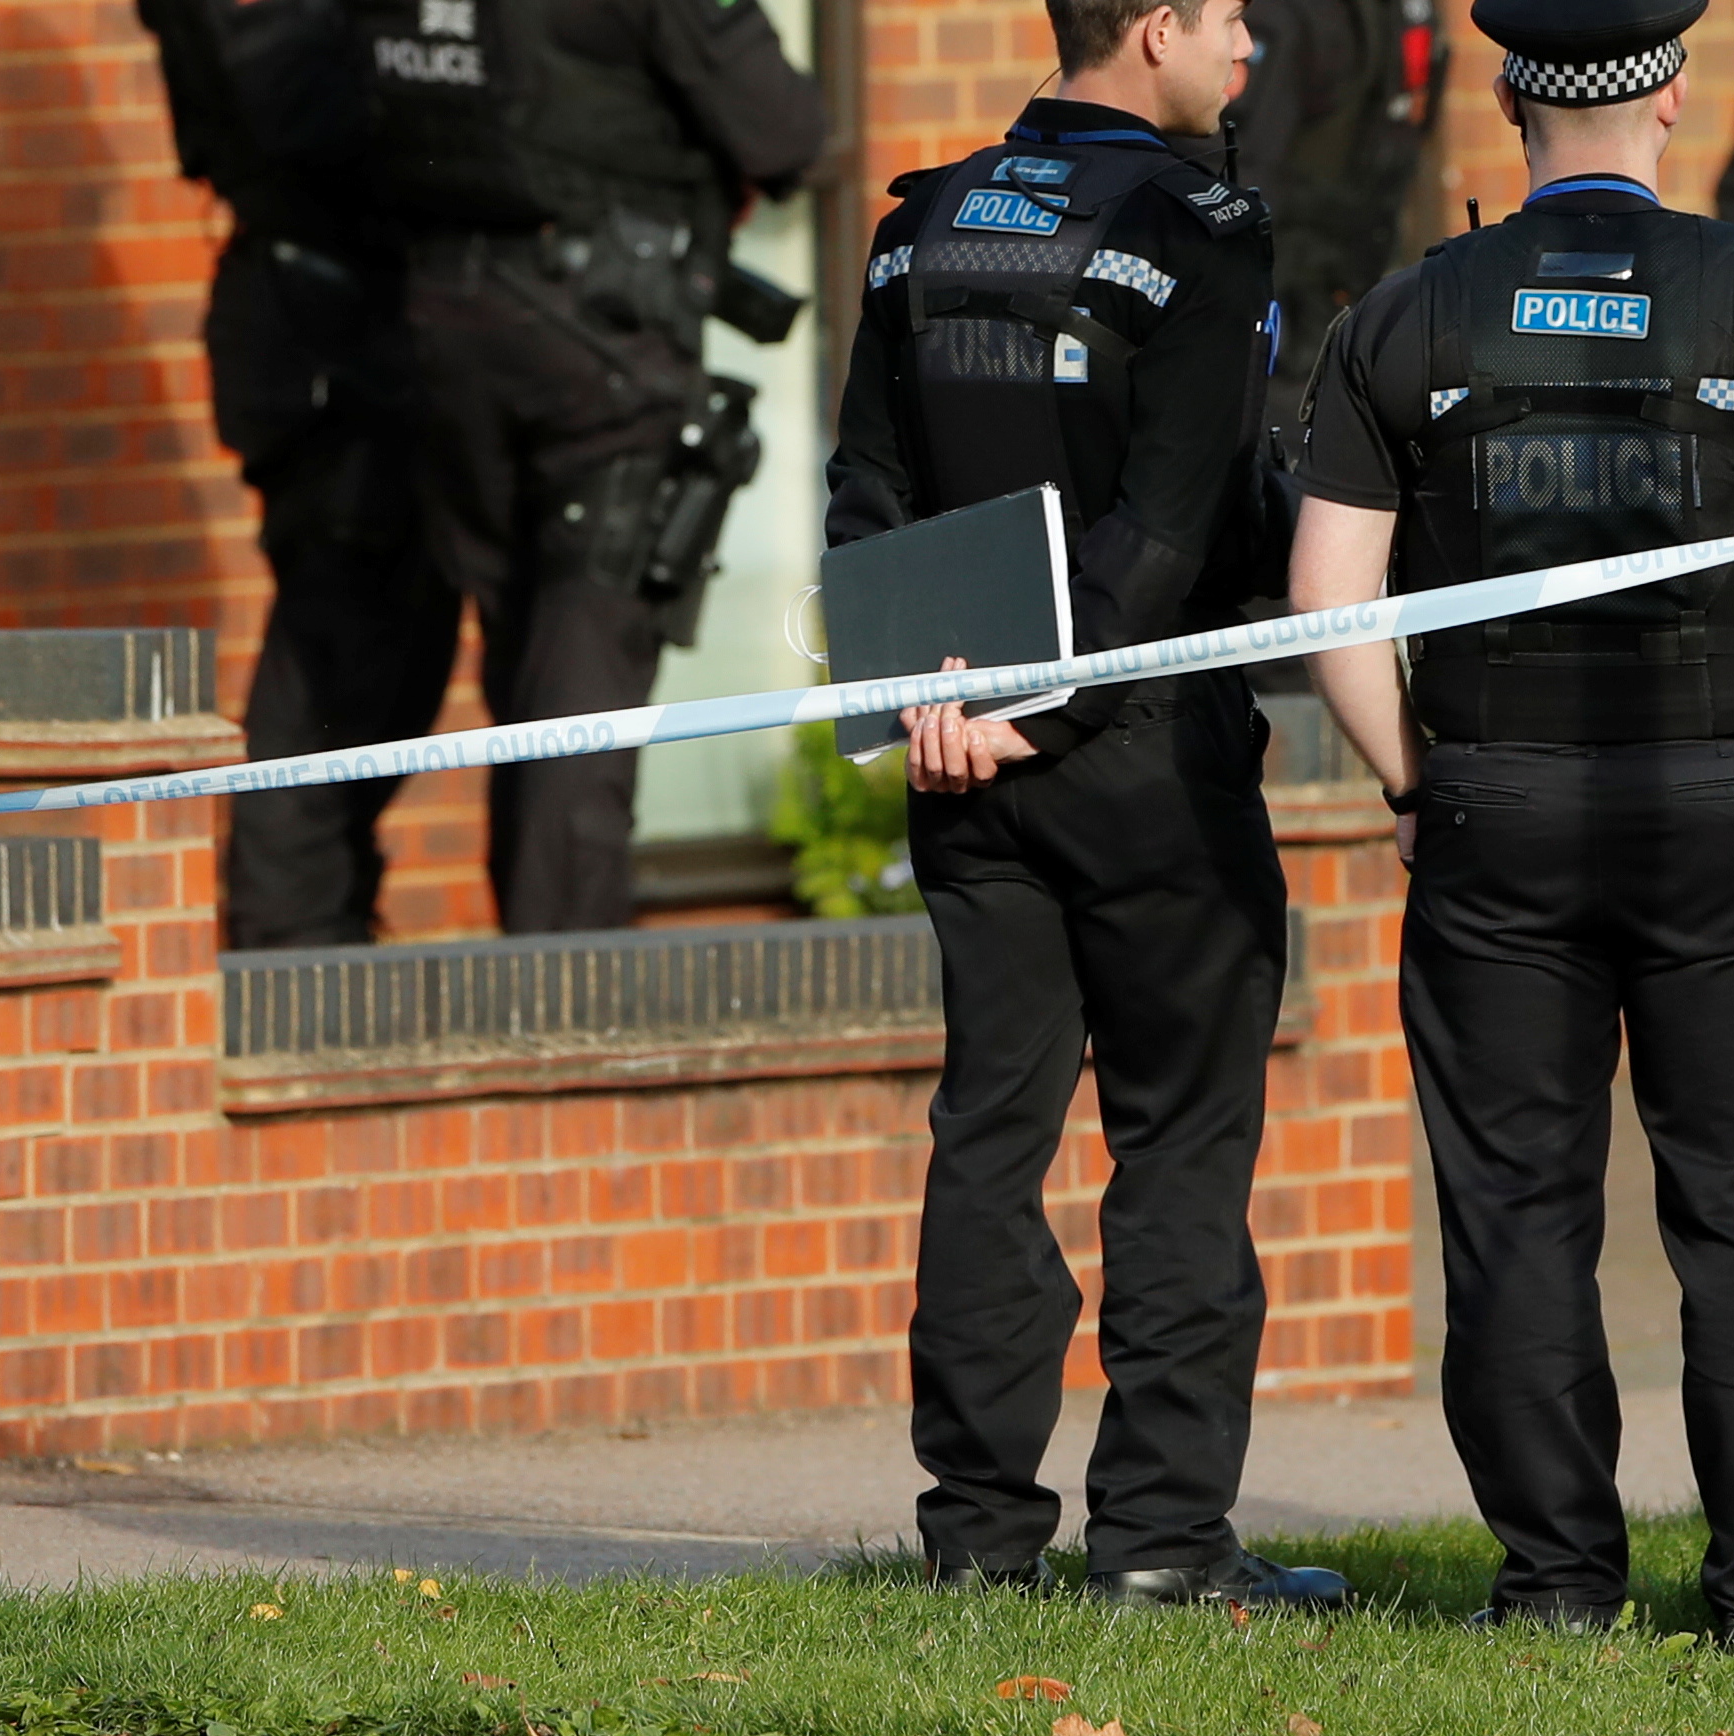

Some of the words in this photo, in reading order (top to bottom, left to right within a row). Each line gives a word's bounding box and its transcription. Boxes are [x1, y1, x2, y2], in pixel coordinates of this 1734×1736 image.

[374, 37, 485, 85] POLICE
[966, 195, 1057, 228] POLICE
[1209, 198, 1250, 224] 74739
[1522, 297, 1639, 331] POLICE
